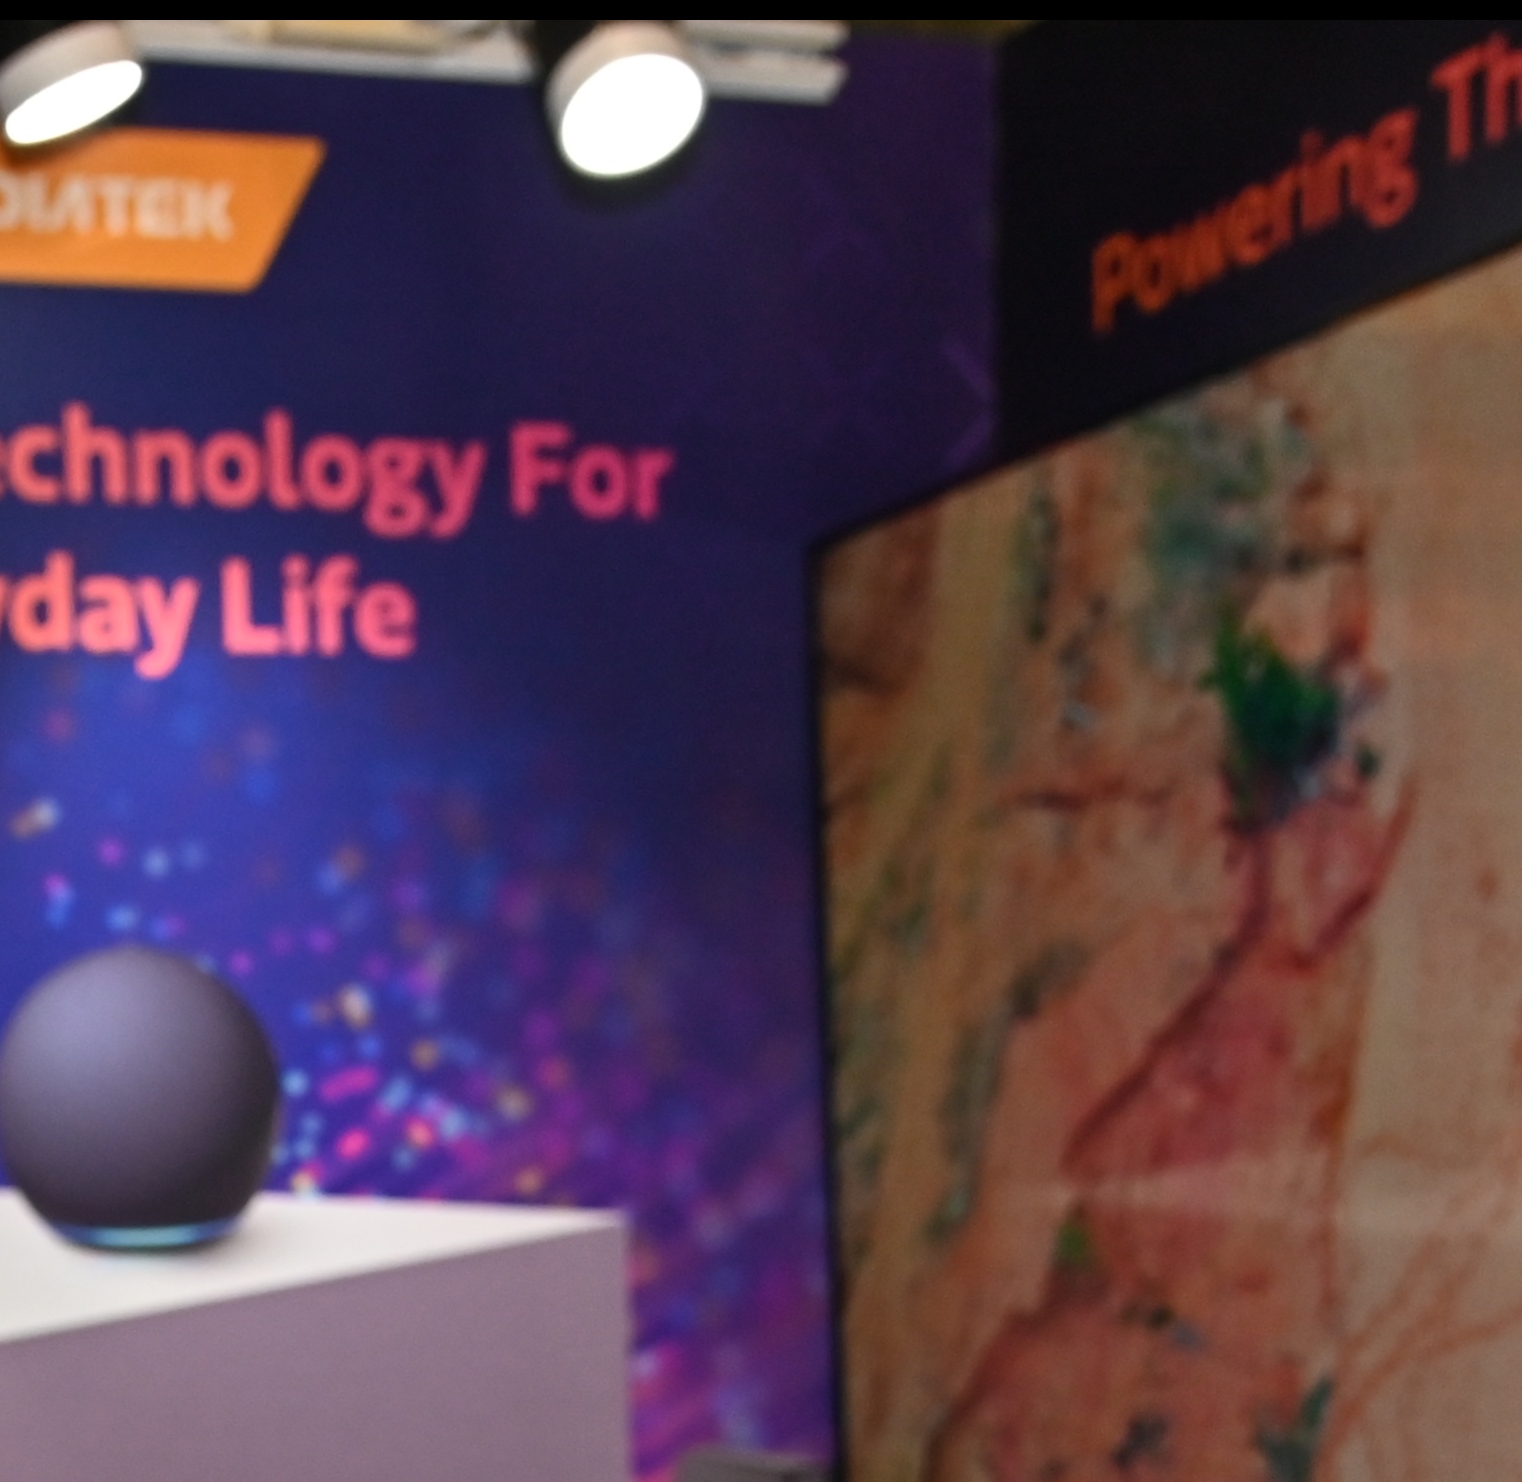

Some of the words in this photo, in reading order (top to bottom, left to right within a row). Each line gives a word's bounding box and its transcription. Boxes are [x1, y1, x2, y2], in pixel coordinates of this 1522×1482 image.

[1090, 110, 1420, 333] Powering
[508, 423, 672, 519] For
[218, 558, 416, 655] Life
